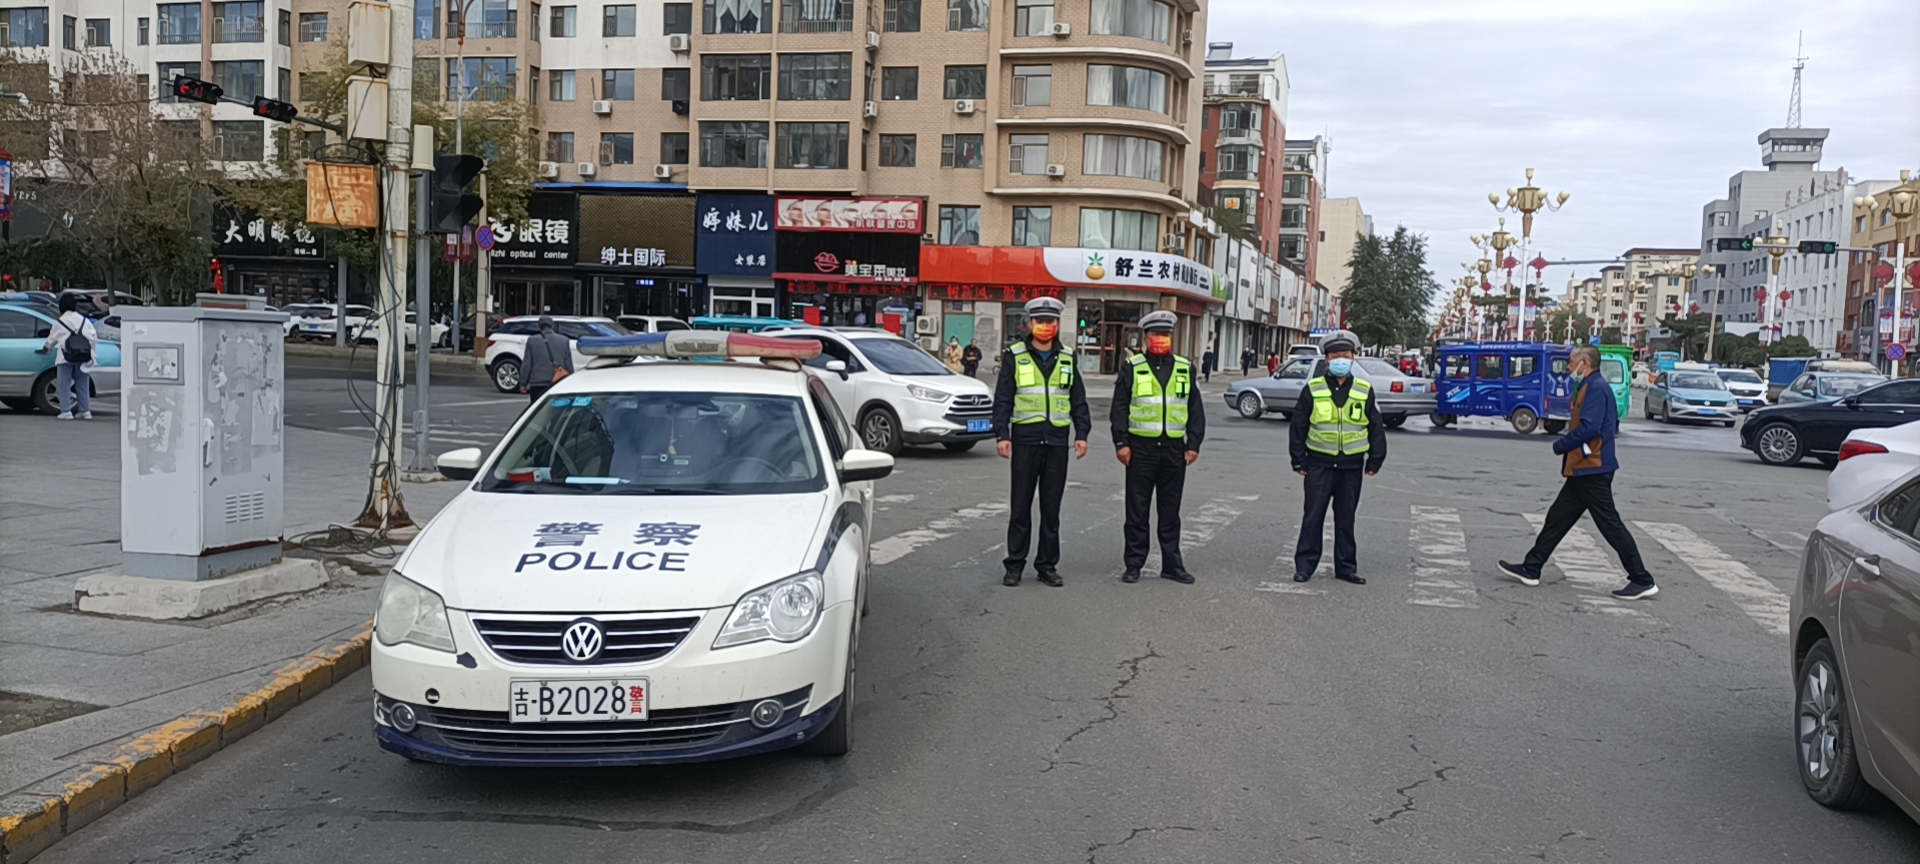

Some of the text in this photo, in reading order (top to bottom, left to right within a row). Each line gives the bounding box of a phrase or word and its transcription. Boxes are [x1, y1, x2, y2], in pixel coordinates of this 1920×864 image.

[510, 249, 536, 260] optical
[544, 251, 569, 260] center
[601, 247, 666, 266] 绅士国际
[514, 551, 690, 573] POLICE
